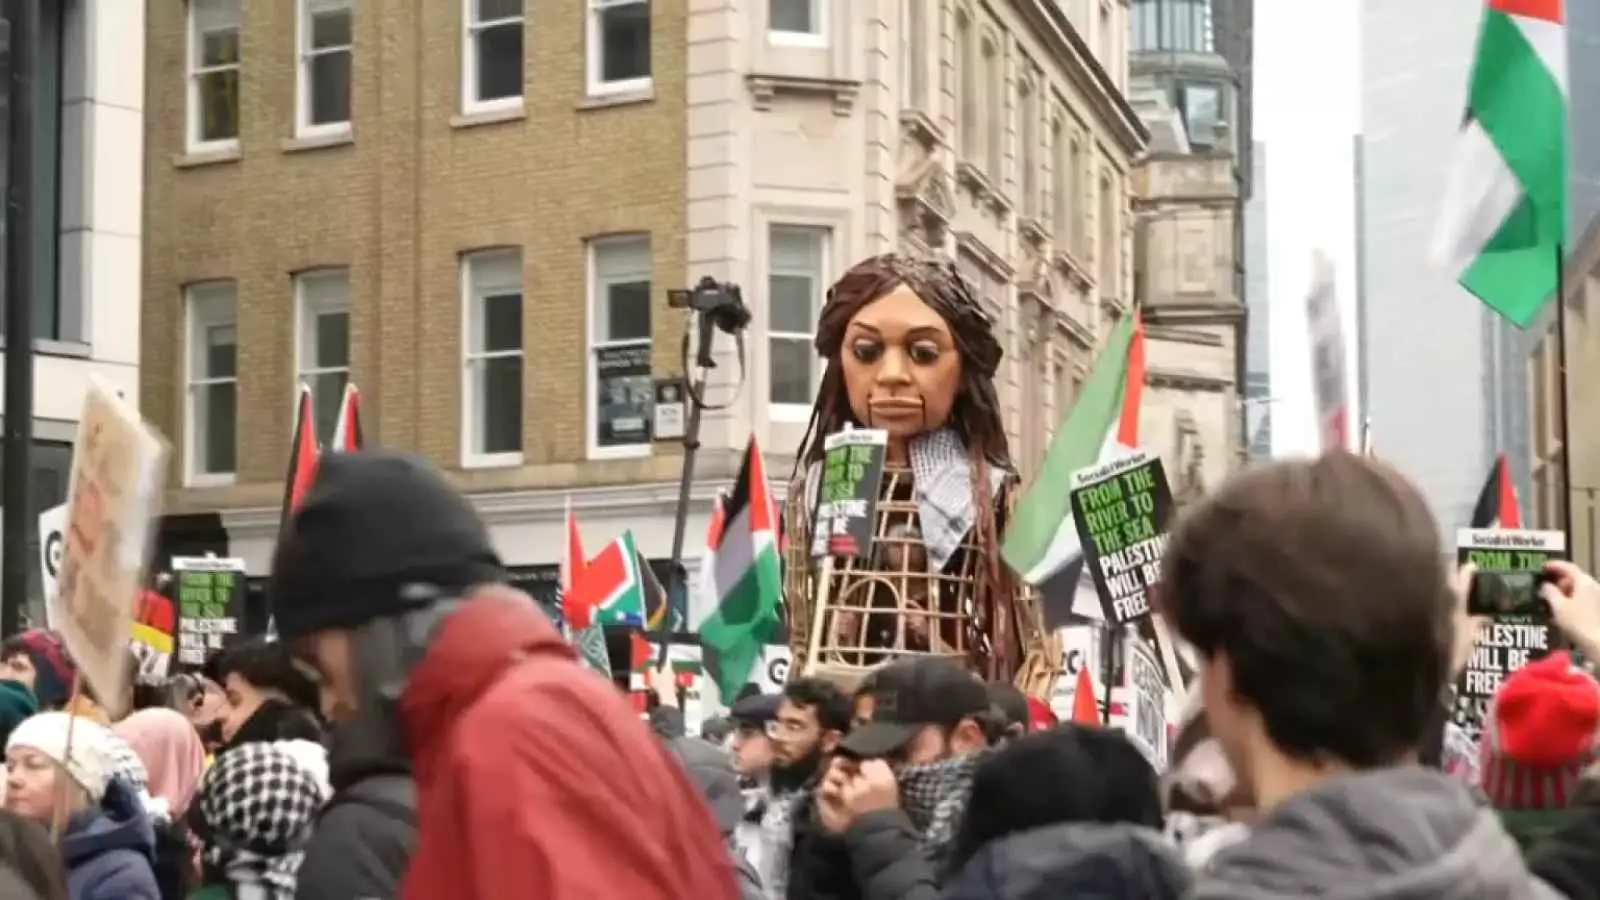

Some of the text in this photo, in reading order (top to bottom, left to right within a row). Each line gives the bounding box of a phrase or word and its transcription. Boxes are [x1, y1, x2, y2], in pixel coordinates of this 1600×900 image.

[1078, 466, 1156, 513] FROM THE
[1085, 491, 1154, 534] RIVER TO
[1093, 516, 1156, 555] THE SEA
[1104, 559, 1161, 600] WILL BE
[1112, 590, 1151, 623] FREE
[1473, 624, 1549, 650] ALESTINE
